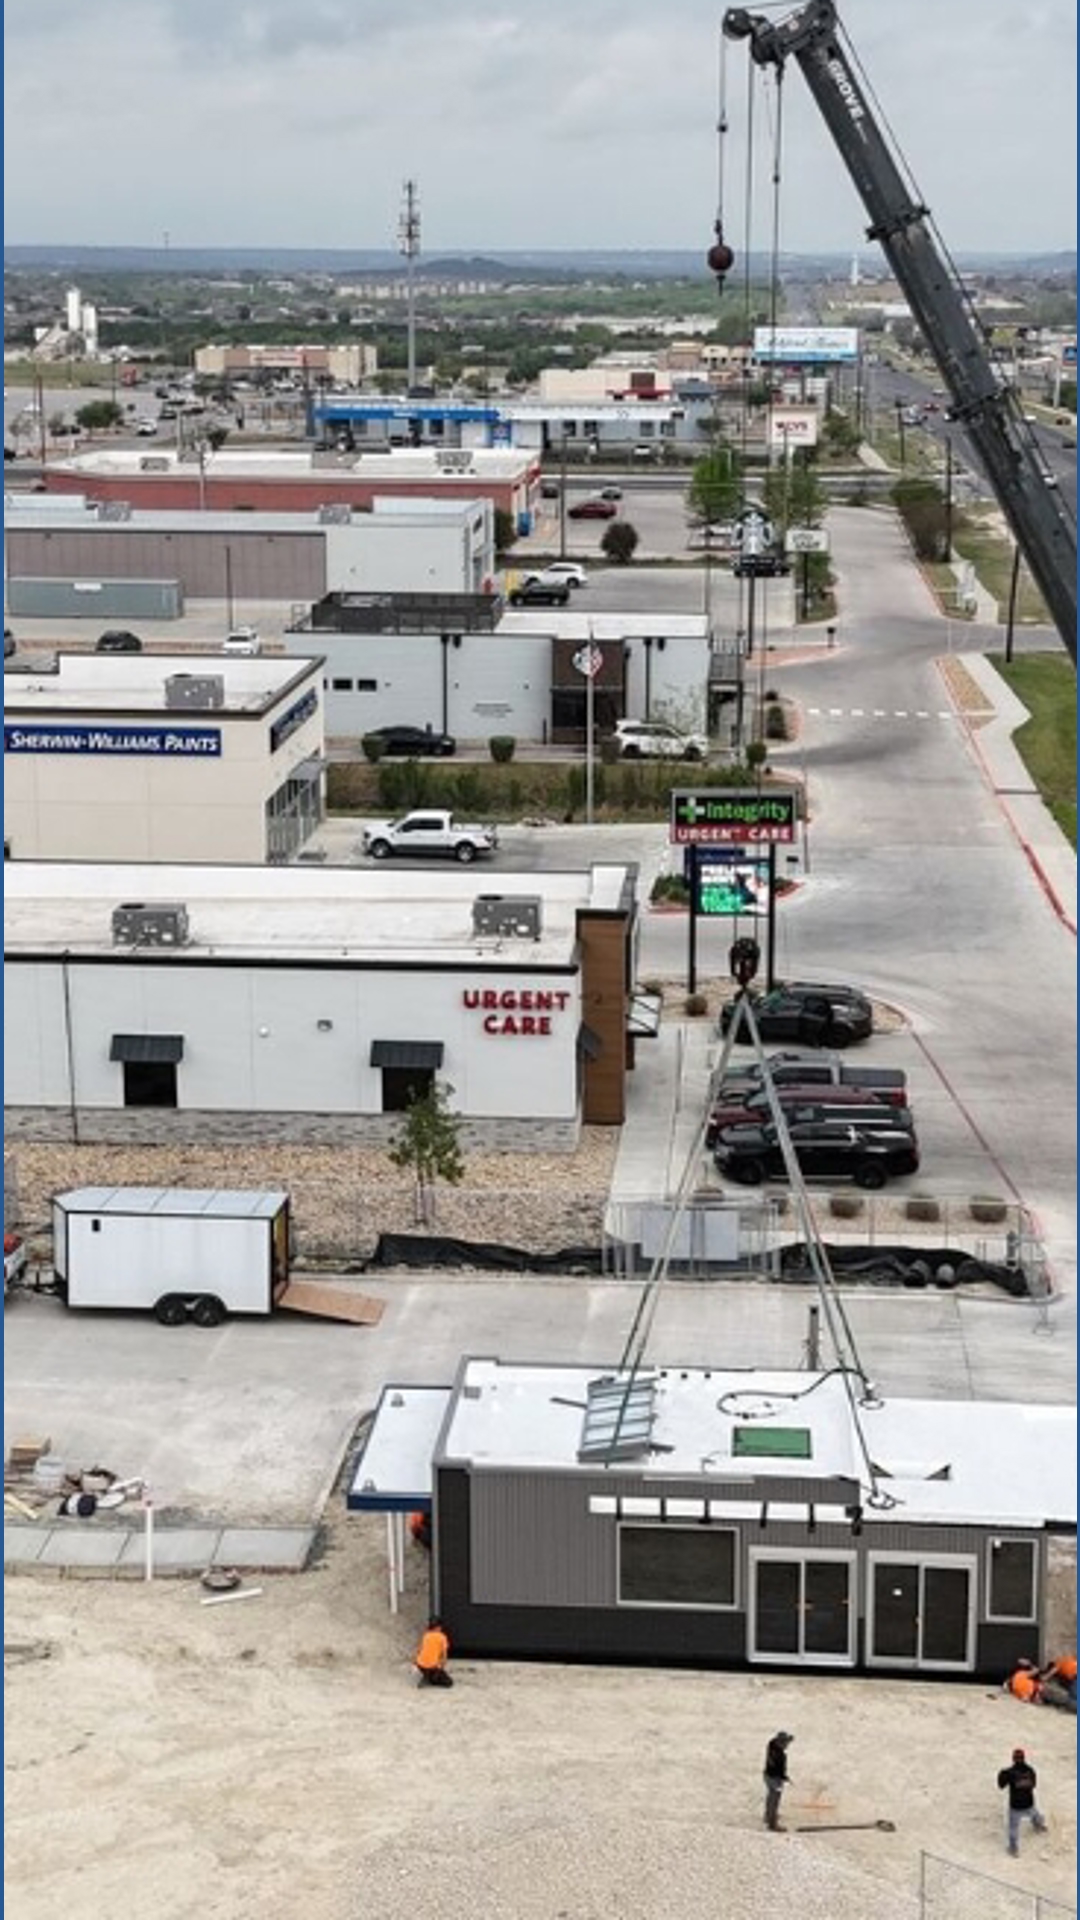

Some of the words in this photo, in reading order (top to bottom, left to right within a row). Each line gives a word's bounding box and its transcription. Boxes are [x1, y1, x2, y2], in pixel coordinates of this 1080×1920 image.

[828, 60, 864, 118] GROVE
[10, 731, 160, 750] SHERWIN-WILLIAMS
[164, 733, 217, 751] PAINTS
[748, 827, 790, 840] CARE
[463, 989, 570, 1011] URGENT
[484, 1014, 551, 1035] CARE
